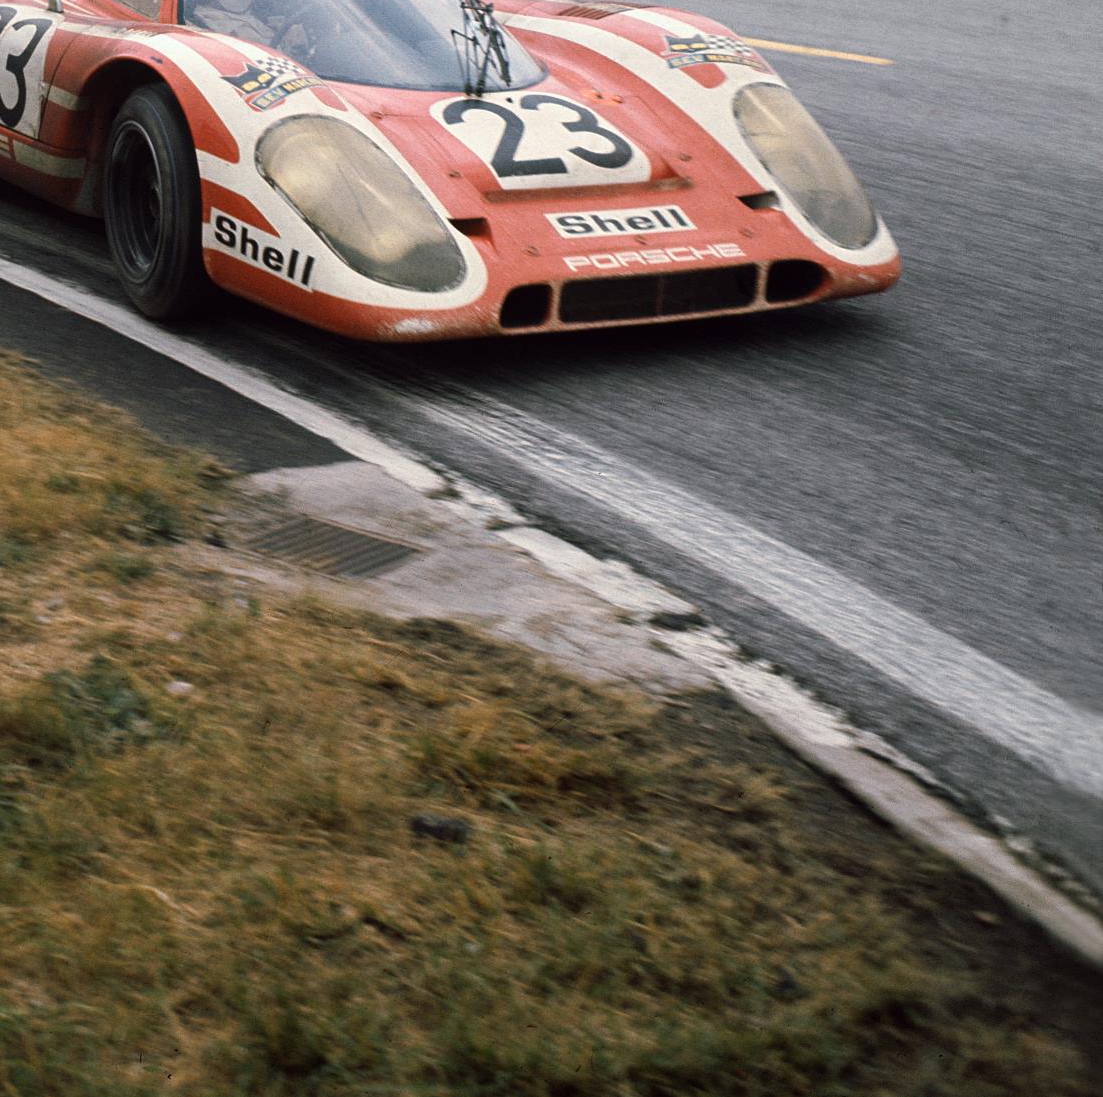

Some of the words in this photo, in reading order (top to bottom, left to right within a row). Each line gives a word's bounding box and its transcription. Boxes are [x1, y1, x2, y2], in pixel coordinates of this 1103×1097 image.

[442, 94, 634, 178] 23
[556, 208, 688, 235] Shell
[214, 214, 316, 287] Shell
[562, 243, 747, 272] PORSCHE
